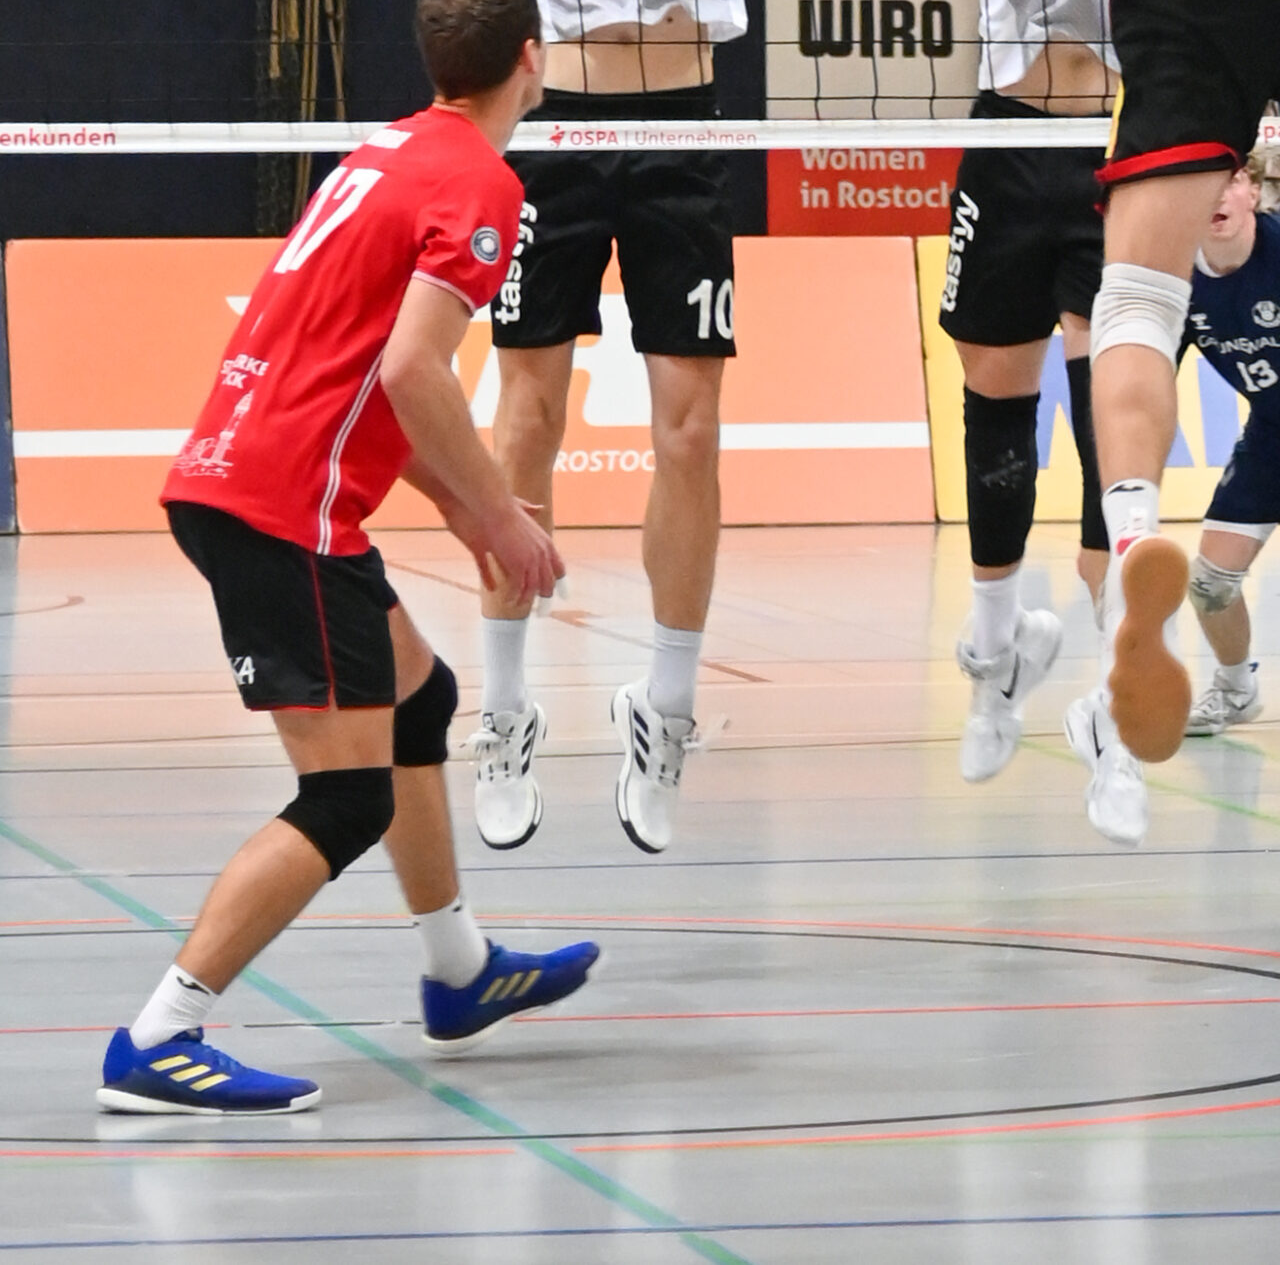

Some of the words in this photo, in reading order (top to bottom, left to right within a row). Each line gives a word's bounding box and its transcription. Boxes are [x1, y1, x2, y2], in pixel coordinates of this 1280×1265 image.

[570, 130, 618, 146] OSPA
[635, 130, 757, 146] Unternehmen
[801, 148, 925, 171] Wohnen
[801, 181, 828, 208] in
[1236, 359, 1279, 392] 13
[552, 449, 657, 473] ROSTOC
